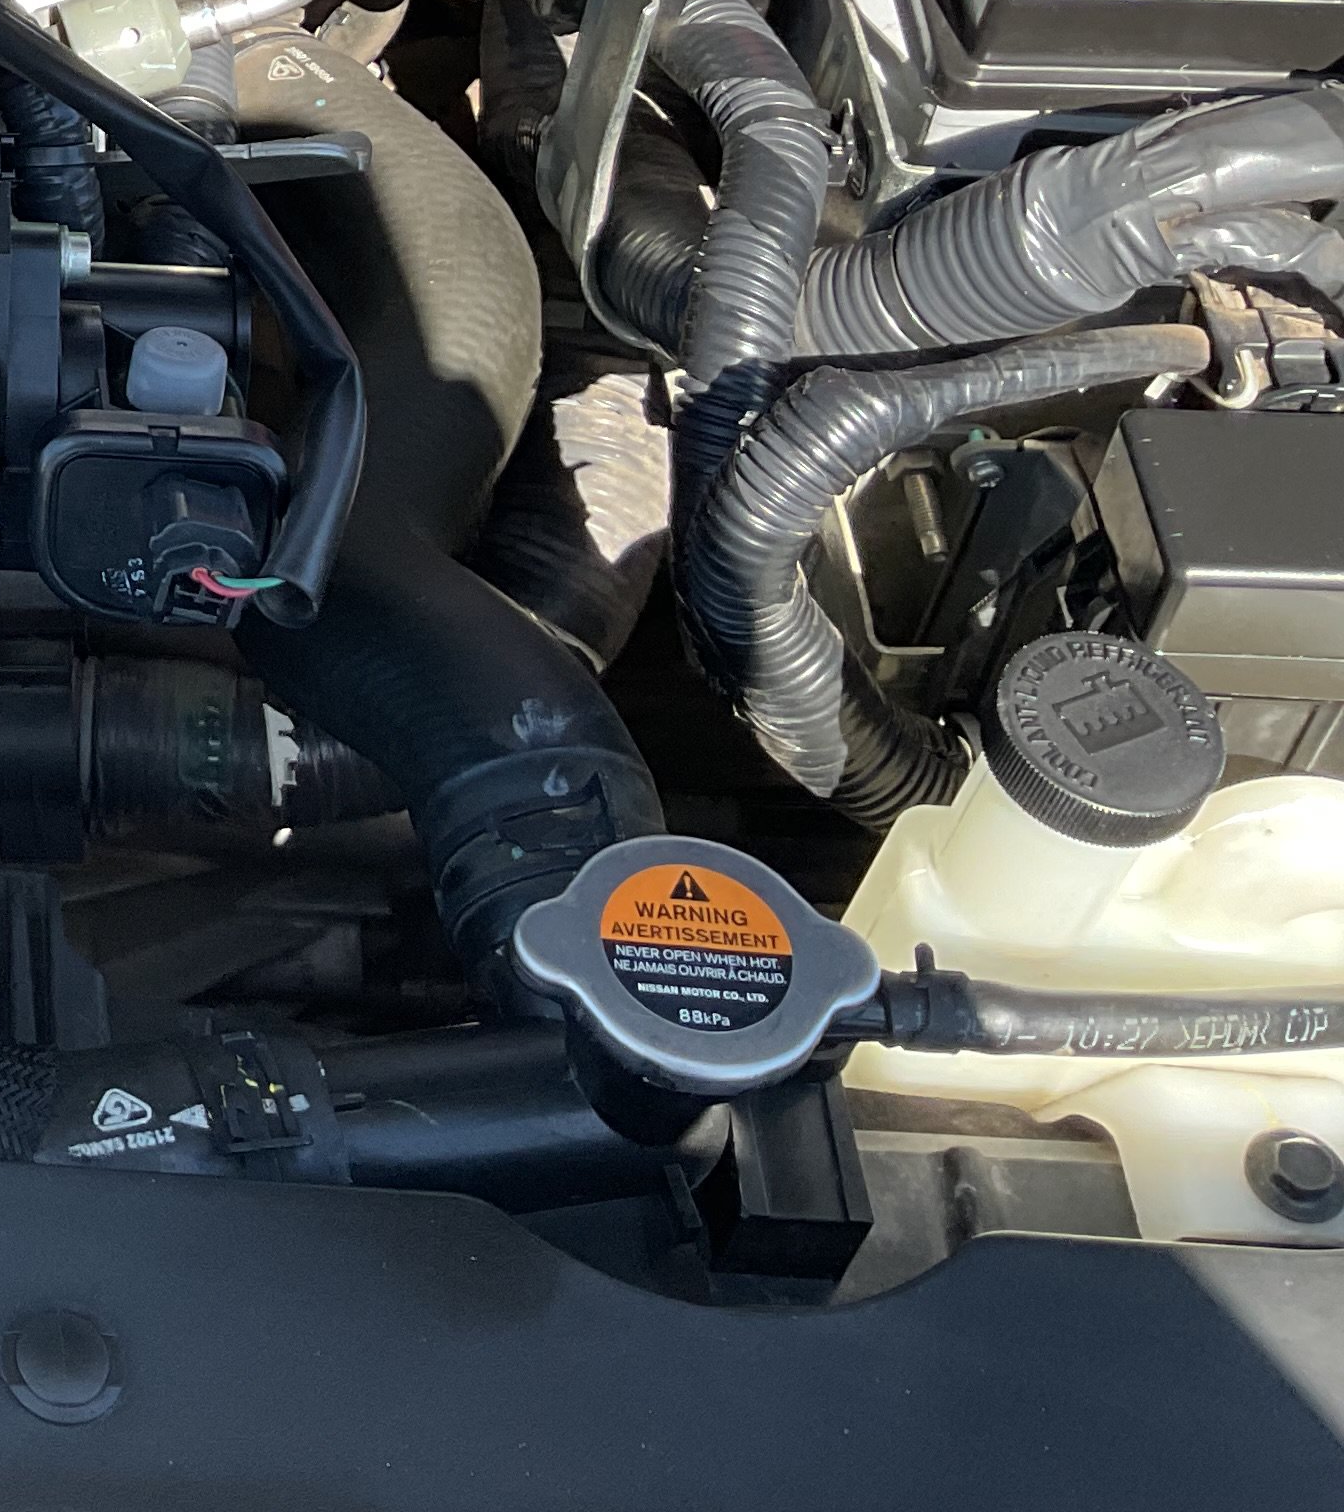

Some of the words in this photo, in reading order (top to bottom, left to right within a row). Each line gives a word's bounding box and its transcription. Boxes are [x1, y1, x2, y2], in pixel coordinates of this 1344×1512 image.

[1067, 641, 1212, 747] REFRIGERANT
[634, 901, 748, 926] WARNING
[612, 921, 779, 949] AVERTISSEMENT
[615, 944, 660, 959] NEVER
[663, 948, 701, 962] OPEN
[706, 952, 747, 967] WHEN
[749, 957, 781, 970] HOT.
[613, 959, 631, 970] NE
[631, 960, 676, 975] JAMAIS
[678, 964, 726, 979] OUVRIR
[737, 970, 787, 984] CHAUD.
[638, 982, 679, 995] NISSAN
[681, 986, 721, 999] MOTOR
[747, 992, 769, 1003] LTD.
[679, 1008, 730, 1026] 88kPa
